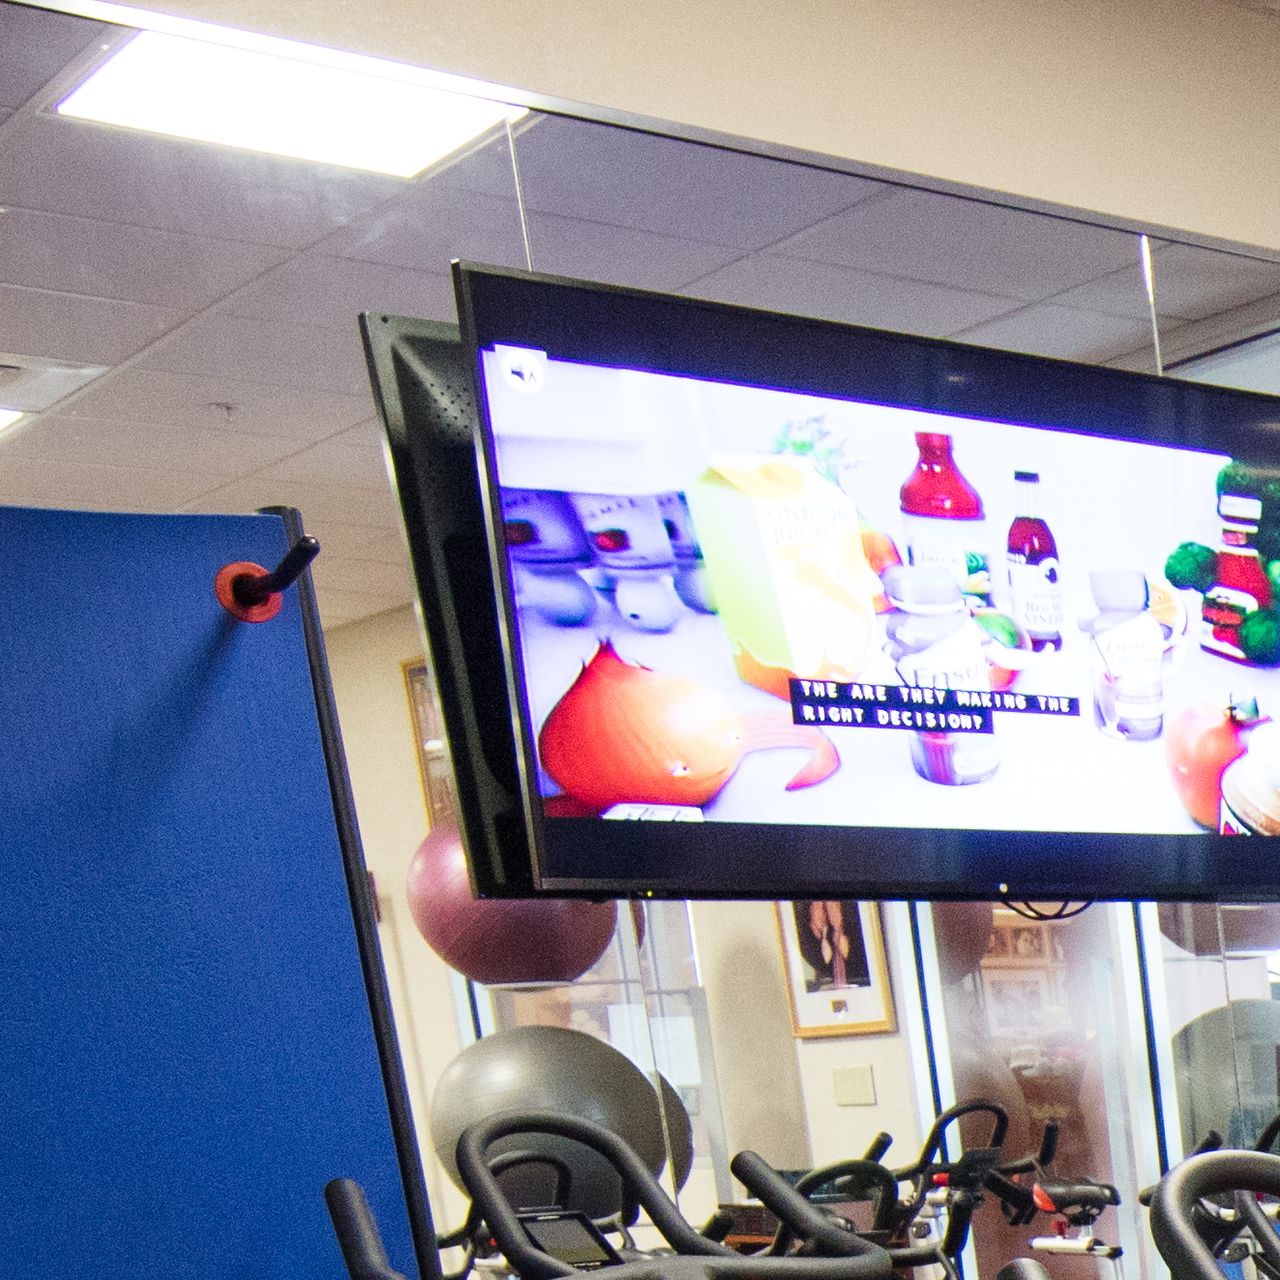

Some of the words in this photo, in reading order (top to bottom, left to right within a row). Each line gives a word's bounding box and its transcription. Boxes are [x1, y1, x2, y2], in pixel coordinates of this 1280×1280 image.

[800, 680, 838, 699] THE
[851, 682, 887, 702] ARE
[900, 687, 946, 706] THEY
[956, 690, 1027, 710] MAKING
[1037, 695, 1071, 713] THE
[802, 705, 864, 724] RIGHT
[877, 709, 983, 731] DECISION?
